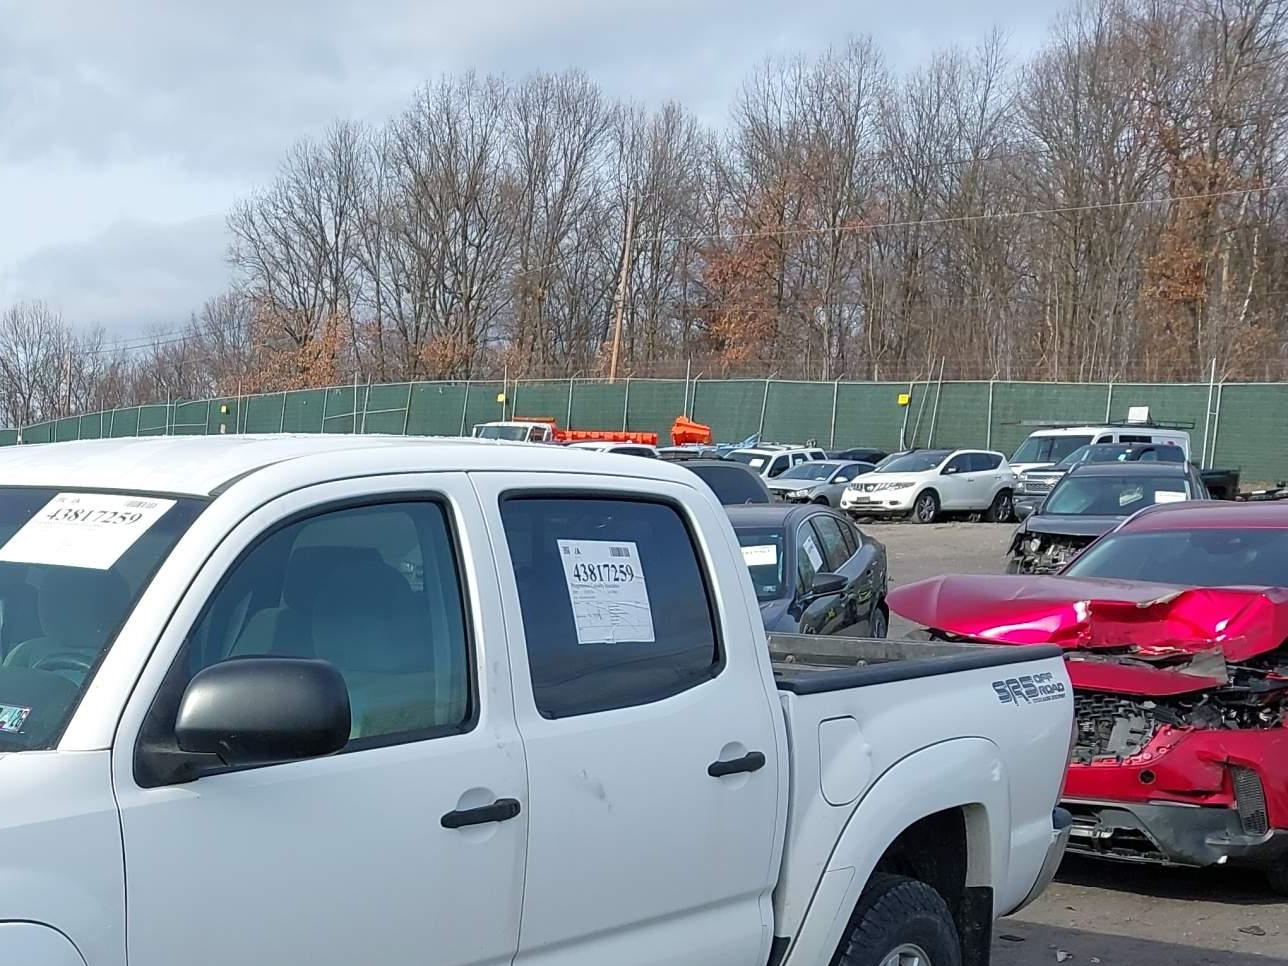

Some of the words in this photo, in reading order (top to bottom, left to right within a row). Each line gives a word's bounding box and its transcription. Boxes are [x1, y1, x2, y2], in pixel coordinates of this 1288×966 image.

[46, 508, 143, 524] 43817259
[573, 563, 634, 582] 43817259
[992, 675, 1039, 706] SR5
[1032, 672, 1053, 684] OFF
[1038, 682, 1065, 696] ROAD
